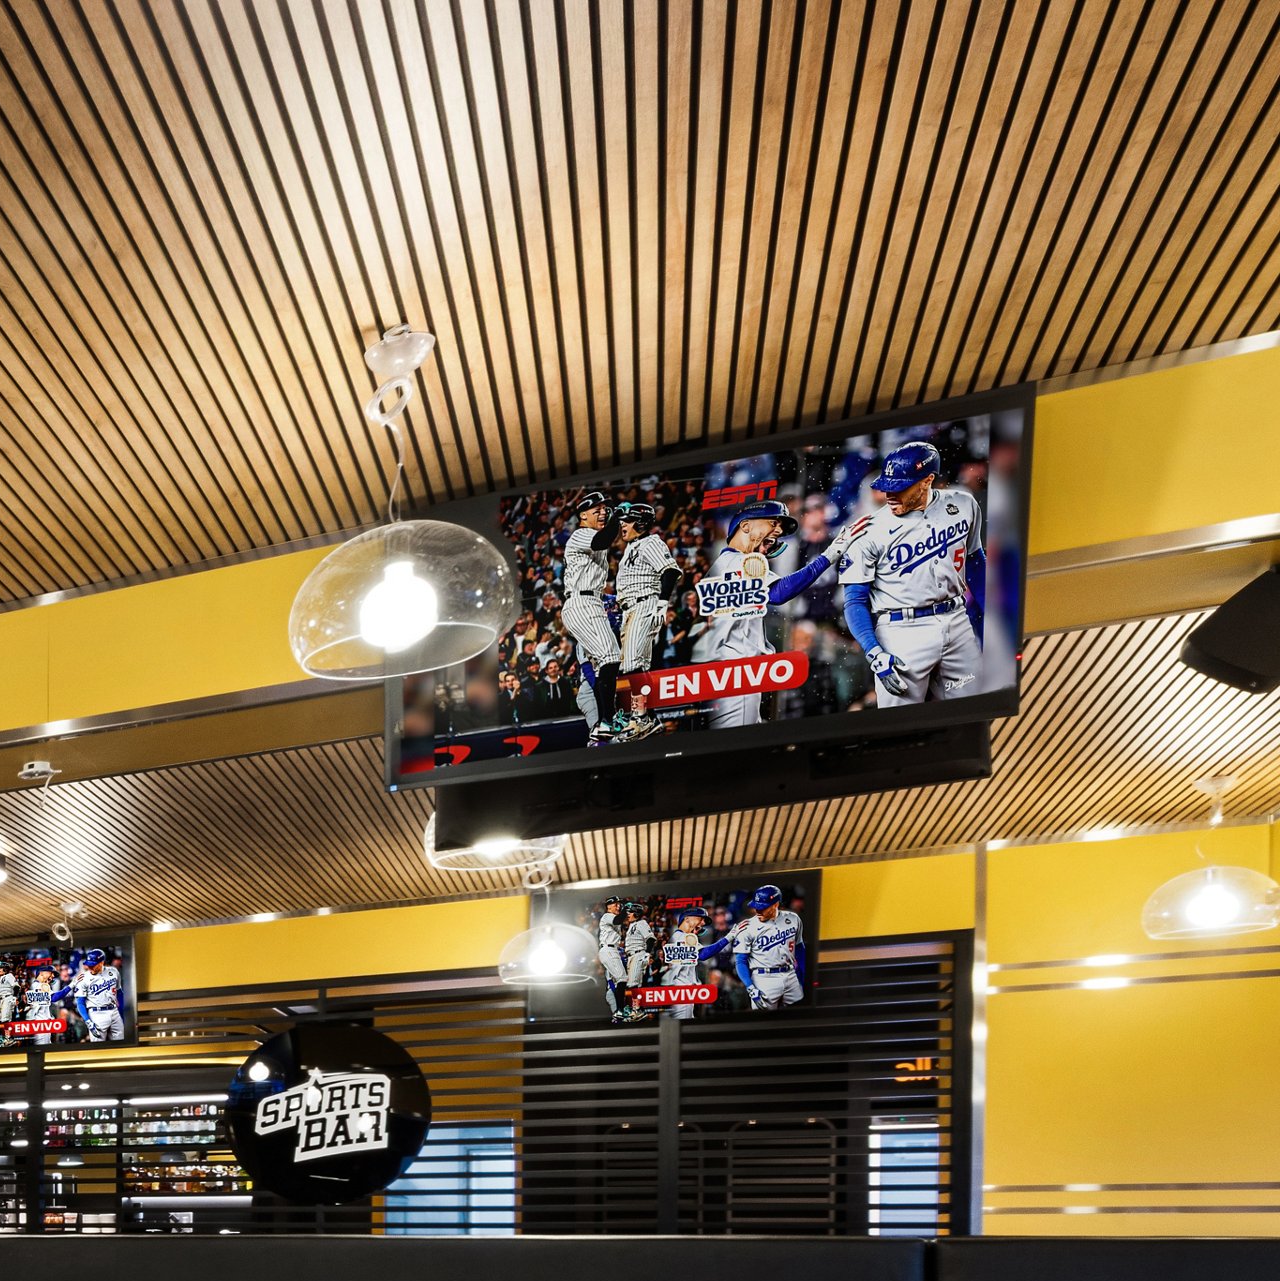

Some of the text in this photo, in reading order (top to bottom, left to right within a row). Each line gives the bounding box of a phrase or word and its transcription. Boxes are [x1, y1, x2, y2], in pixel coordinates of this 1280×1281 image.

[702, 480, 778, 510] ESPN
[890, 518, 969, 570] Dodgers
[953, 548, 965, 573] 5
[699, 579, 763, 597] WORLD
[702, 590, 767, 613] SERIES
[659, 660, 794, 699] EN VIVO
[666, 897, 703, 909] ESPN
[664, 946, 696, 955] WORLD
[757, 927, 797, 951] Dodgers
[666, 953, 697, 963] SERIES
[645, 988, 711, 1003] EN VIVO
[14, 1021, 62, 1033] EN VIVO
[260, 1082, 385, 1128] SPORTS
[301, 1110, 383, 1153] BAR
